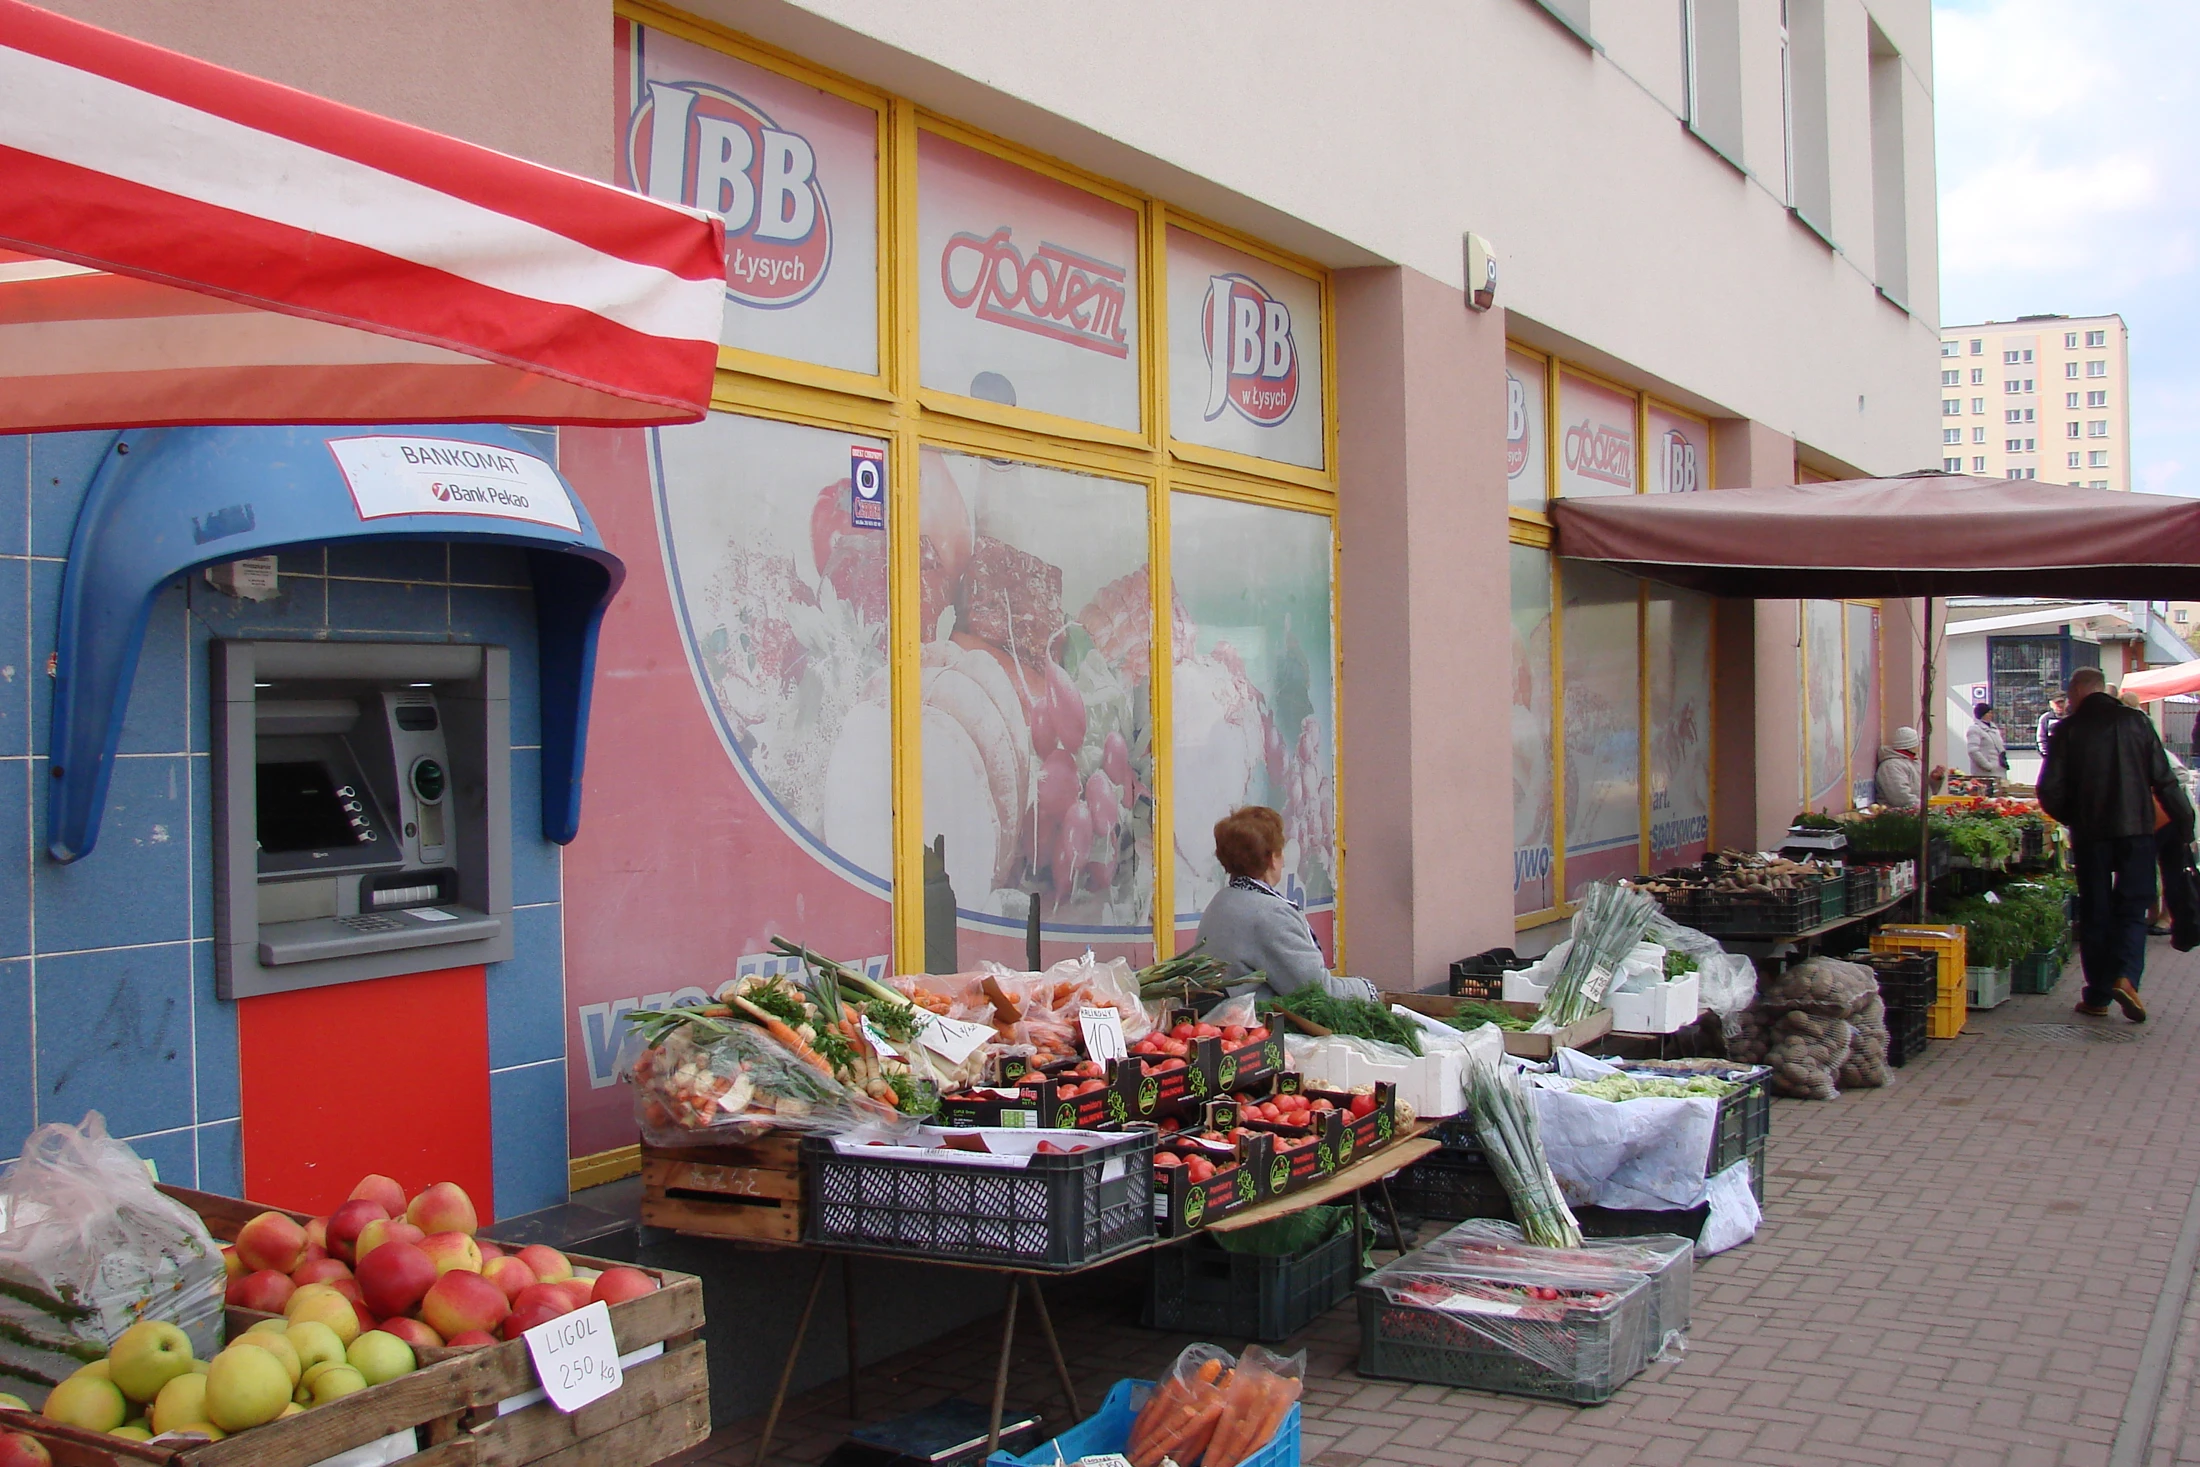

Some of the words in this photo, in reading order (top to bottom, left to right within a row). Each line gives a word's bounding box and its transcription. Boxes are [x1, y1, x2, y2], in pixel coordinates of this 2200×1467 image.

[647, 80, 816, 243] JBB
[733, 248, 805, 286] Łysych
[1204, 276, 1292, 421] JBB
[1252, 386, 1287, 410] Łysych
[401, 445, 521, 475] BANKOMAT
[449, 484, 486, 504] Bank
[489, 487, 529, 508] Pekao
[1653, 787, 1670, 810] art.
[1652, 812, 1707, 858] spożywcze
[1513, 847, 1549, 891] ywo
[1089, 1022, 1116, 1062] 10
[545, 1317, 598, 1354] LIGOL
[560, 1355, 594, 1389] 2,50
[601, 1360, 616, 1384] kg
